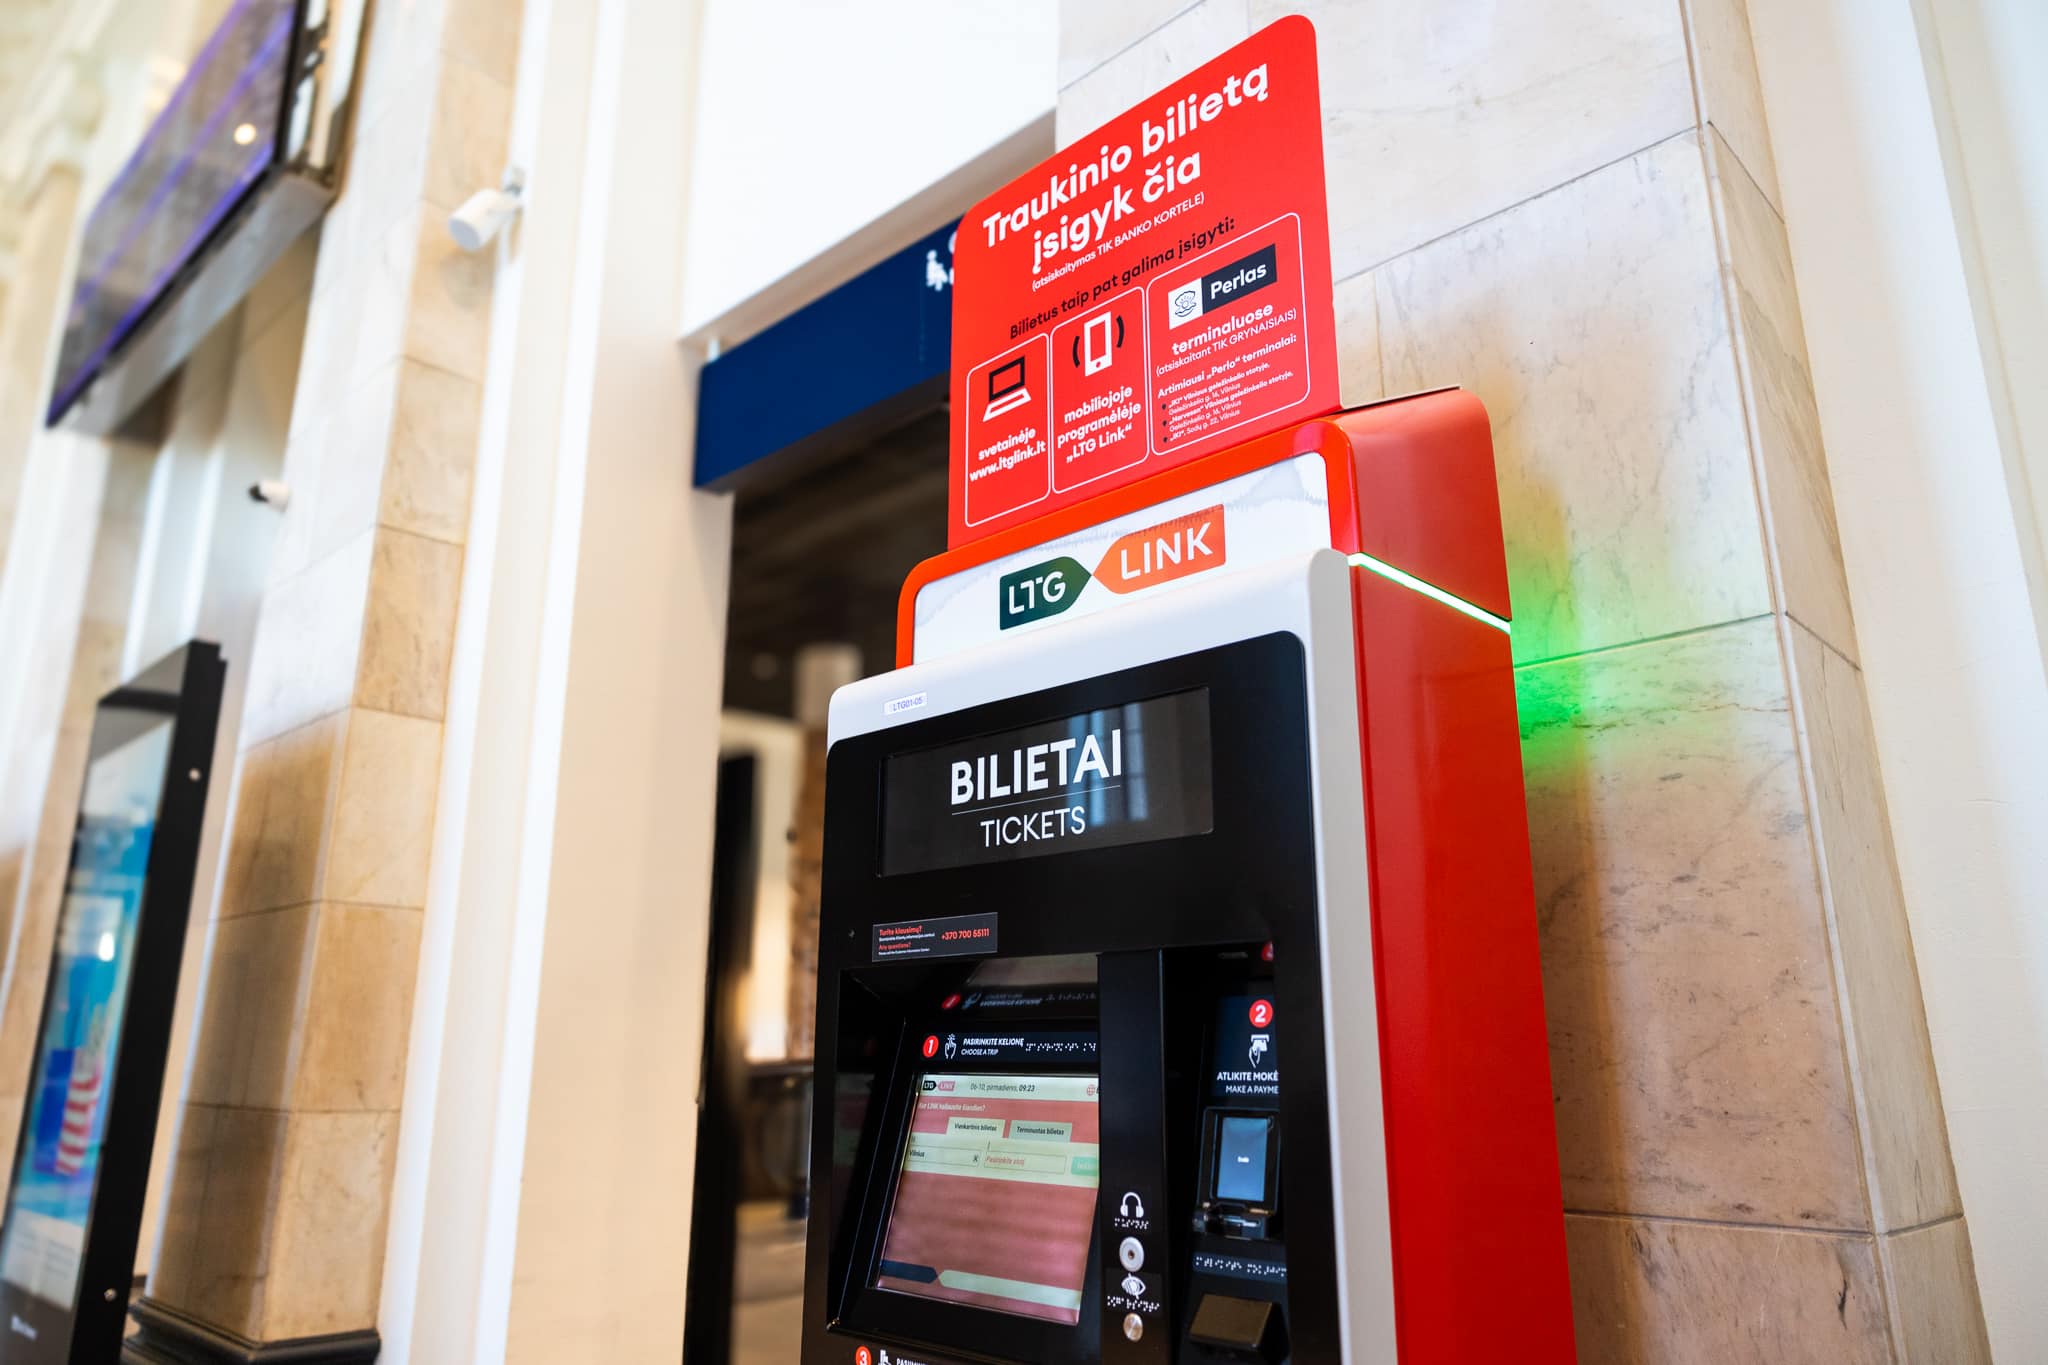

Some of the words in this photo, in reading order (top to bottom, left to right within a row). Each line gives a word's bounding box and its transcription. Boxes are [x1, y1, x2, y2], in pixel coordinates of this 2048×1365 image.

[982, 144, 1132, 248] Traukinio
[1141, 63, 1269, 157] bilietą
[1032, 185, 1135, 275] įsigyk
[1142, 151, 1201, 203] čia
[1032, 251, 1096, 292] (atsiskaitymas
[1097, 240, 1113, 256] TIK
[1114, 220, 1152, 247] BANKO
[1153, 191, 1205, 227] KORTELE)
[1009, 305, 1059, 340] Bilietus
[1061, 290, 1089, 313] taip
[1092, 277, 1118, 301] pat
[1122, 248, 1175, 286] galima
[1178, 216, 1236, 259] įsigyti:
[1210, 262, 1267, 300] Perlas
[1155, 348, 1212, 377] (atsiskaitant
[1213, 340, 1228, 352] TIK
[1229, 308, 1297, 345] GRYNAISIAIS)
[1171, 304, 1274, 355] terminaluose
[1157, 370, 1206, 398] Artimiausi
[1206, 356, 1241, 380] „Perlo“
[1242, 334, 1298, 364] terminalai:
[1063, 386, 1133, 424] mobiliojoje
[978, 427, 1036, 460] svetainėje
[1057, 402, 1142, 449] programėlėje
[1066, 440, 1096, 464] „LTG
[1099, 424, 1132, 448] Link“
[969, 440, 1046, 481] www.ltglink.lt
[1008, 570, 1067, 615] LTG
[1120, 522, 1213, 579] LINK
[950, 729, 1122, 806] BILIETAI
[980, 806, 1087, 848] TICKETS
[941, 931, 957, 941] +370
[958, 929, 972, 939] 700
[1254, 1004, 1266, 1024] 2
[927, 1039, 935, 1055] 1
[960, 1048, 983, 1056] CHOOSE
[987, 1048, 999, 1056] TRIP
[963, 1037, 998, 1047] PASIRINKITE
[998, 1037, 1025, 1048] KELIONĘ
[1018, 1084, 1035, 1093] 09:23
[1216, 1071, 1252, 1082] ATLIKITE
[1225, 1085, 1246, 1094] MAKE
[1246, 1085, 1253, 1094] A
